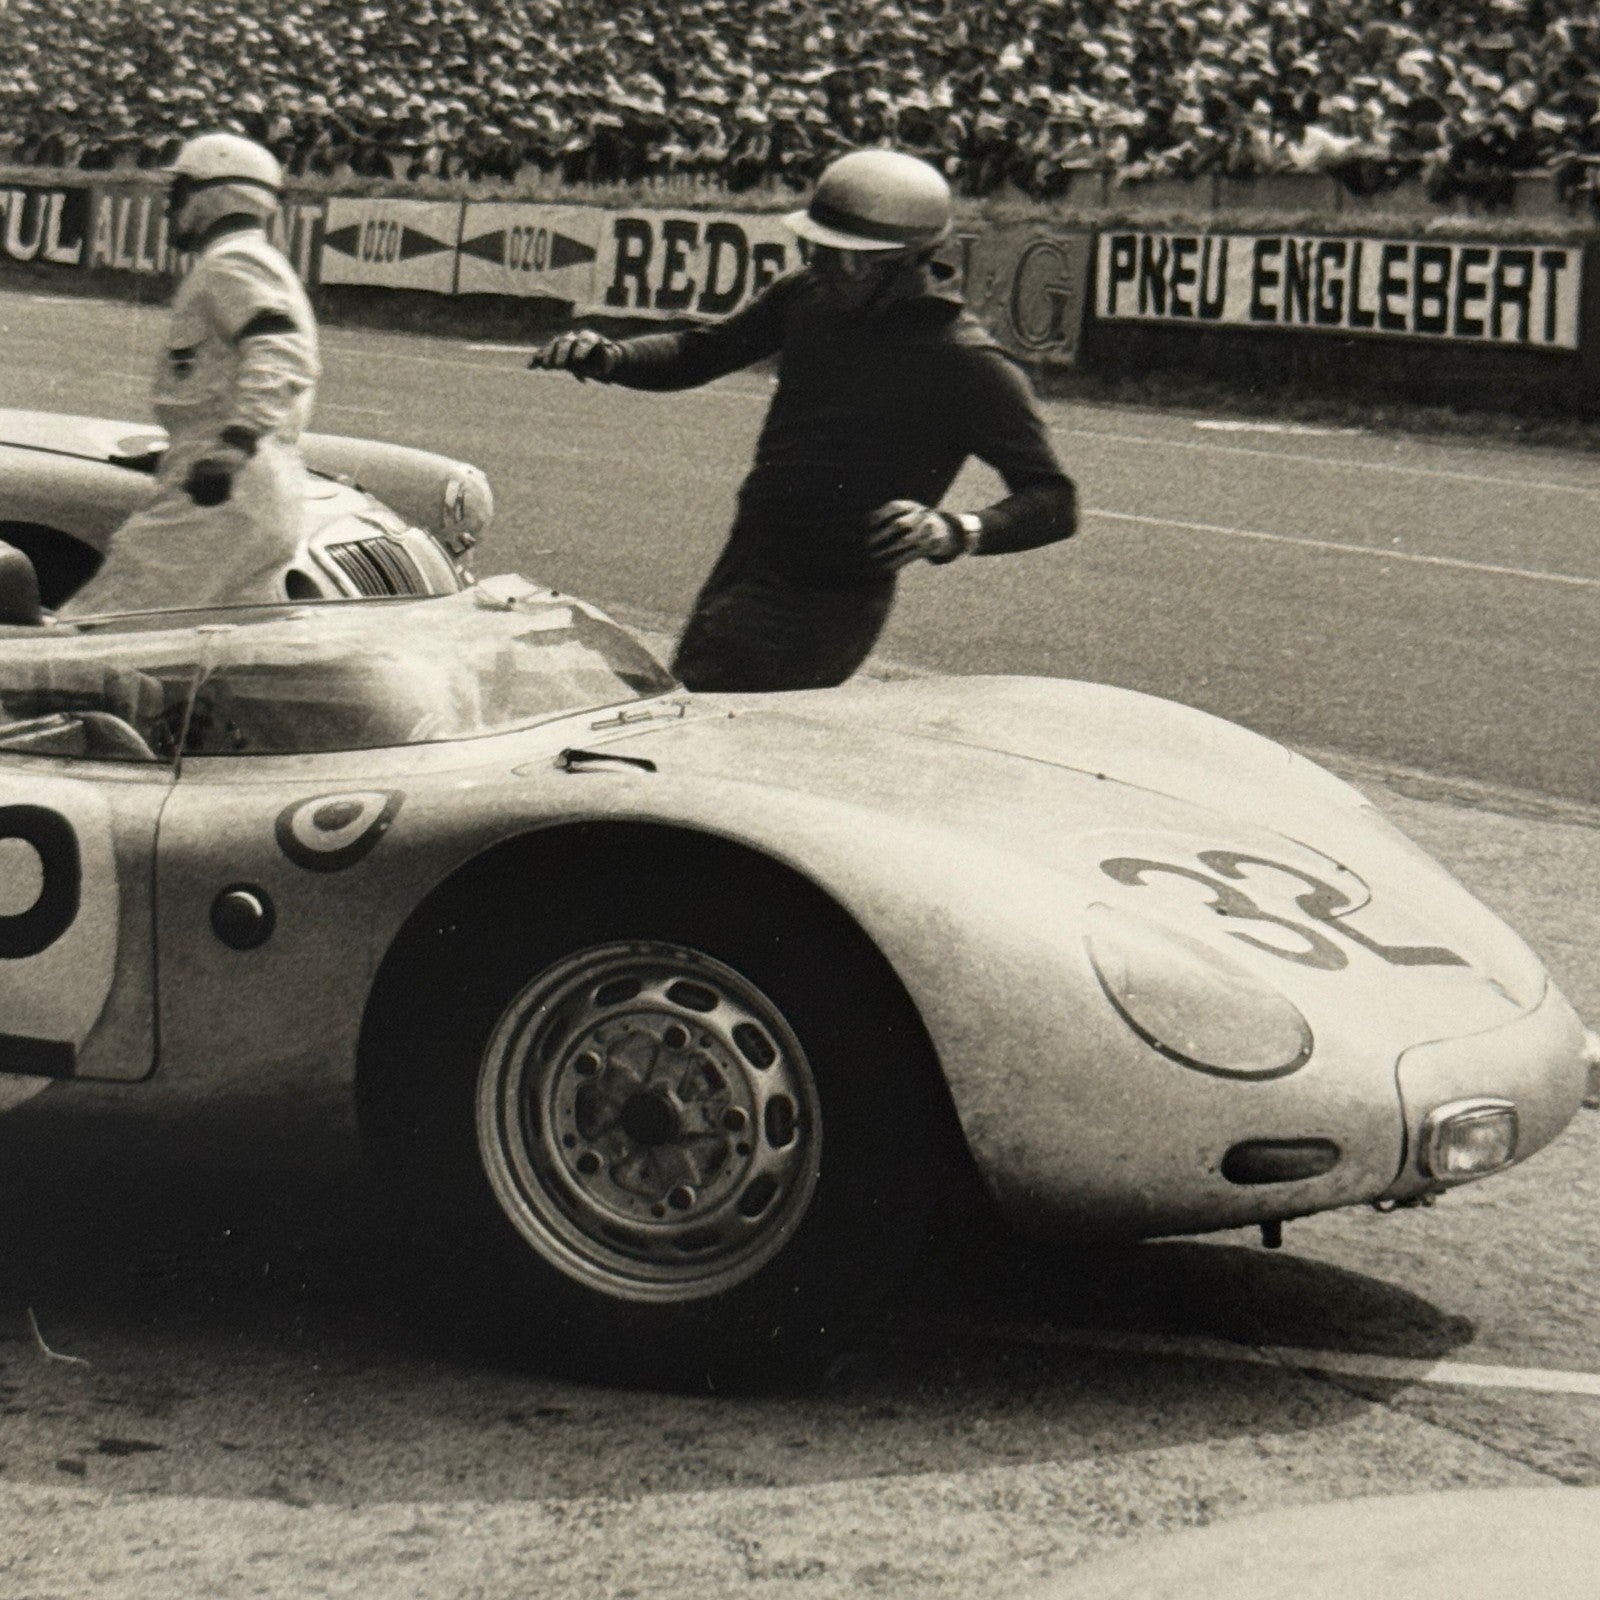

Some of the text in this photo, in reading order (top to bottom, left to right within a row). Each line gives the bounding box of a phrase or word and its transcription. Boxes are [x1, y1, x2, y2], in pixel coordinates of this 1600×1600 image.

[606, 217, 809, 315] REDE
[1109, 234, 1567, 342] PNEU ENGLEBERT
[1099, 850, 1472, 971] 32
